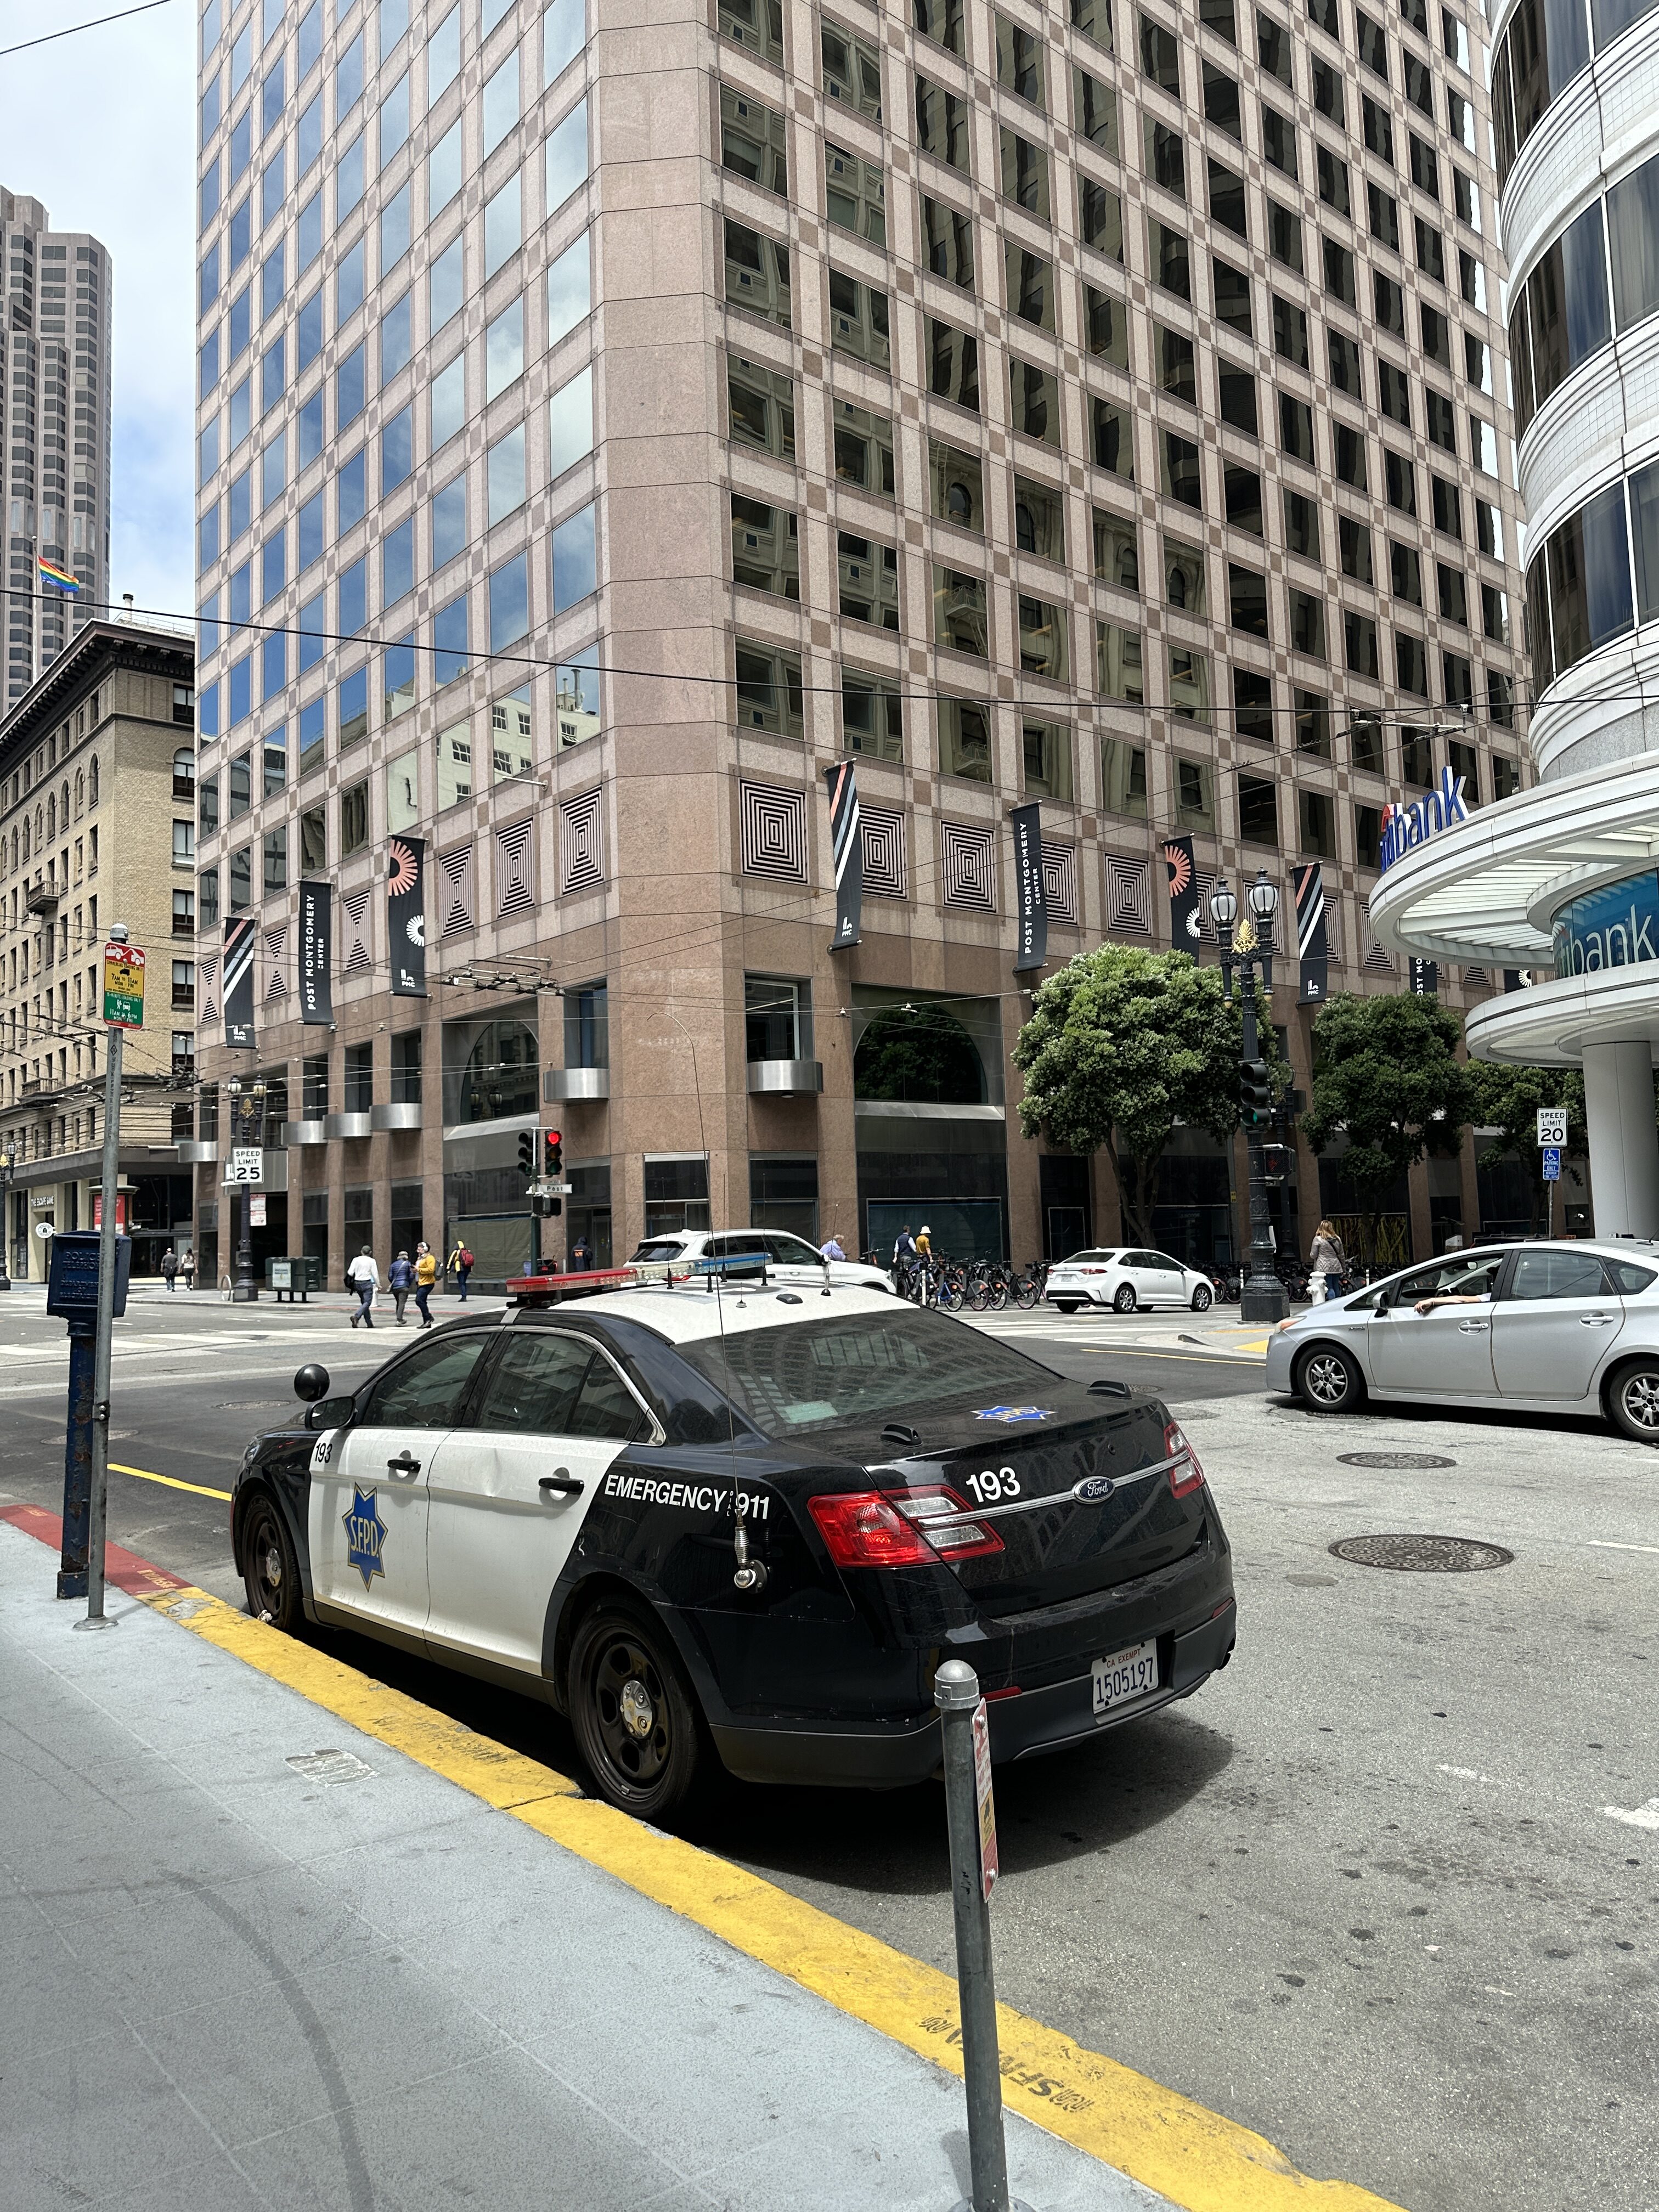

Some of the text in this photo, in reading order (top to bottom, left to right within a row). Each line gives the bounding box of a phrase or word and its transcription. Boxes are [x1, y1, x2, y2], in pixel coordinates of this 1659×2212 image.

[1019, 822, 1033, 954] POST MONTGOMERY
[1032, 868, 1041, 905] CENTER
[842, 929, 852, 937] PMC
[306, 894, 317, 1010] POST MONTGOMERY
[128, 977, 138, 985] 11AM
[110, 1008, 120, 1016] 11AM
[1541, 1128, 1564, 1142] 20
[236, 1167, 260, 1180] 25
[62, 1261, 98, 1269] TELEPHON
[314, 1442, 332, 1464] 193
[966, 1466, 1020, 1503] 193
[1087, 1480, 1108, 1497] Ford
[604, 1474, 770, 1520] EMERGENCY DIAL 911
[349, 1515, 379, 1558] S.F.P.D.
[1107, 1648, 1142, 1668] CA EXEMPT
[1096, 1657, 1153, 1704] 1505197
